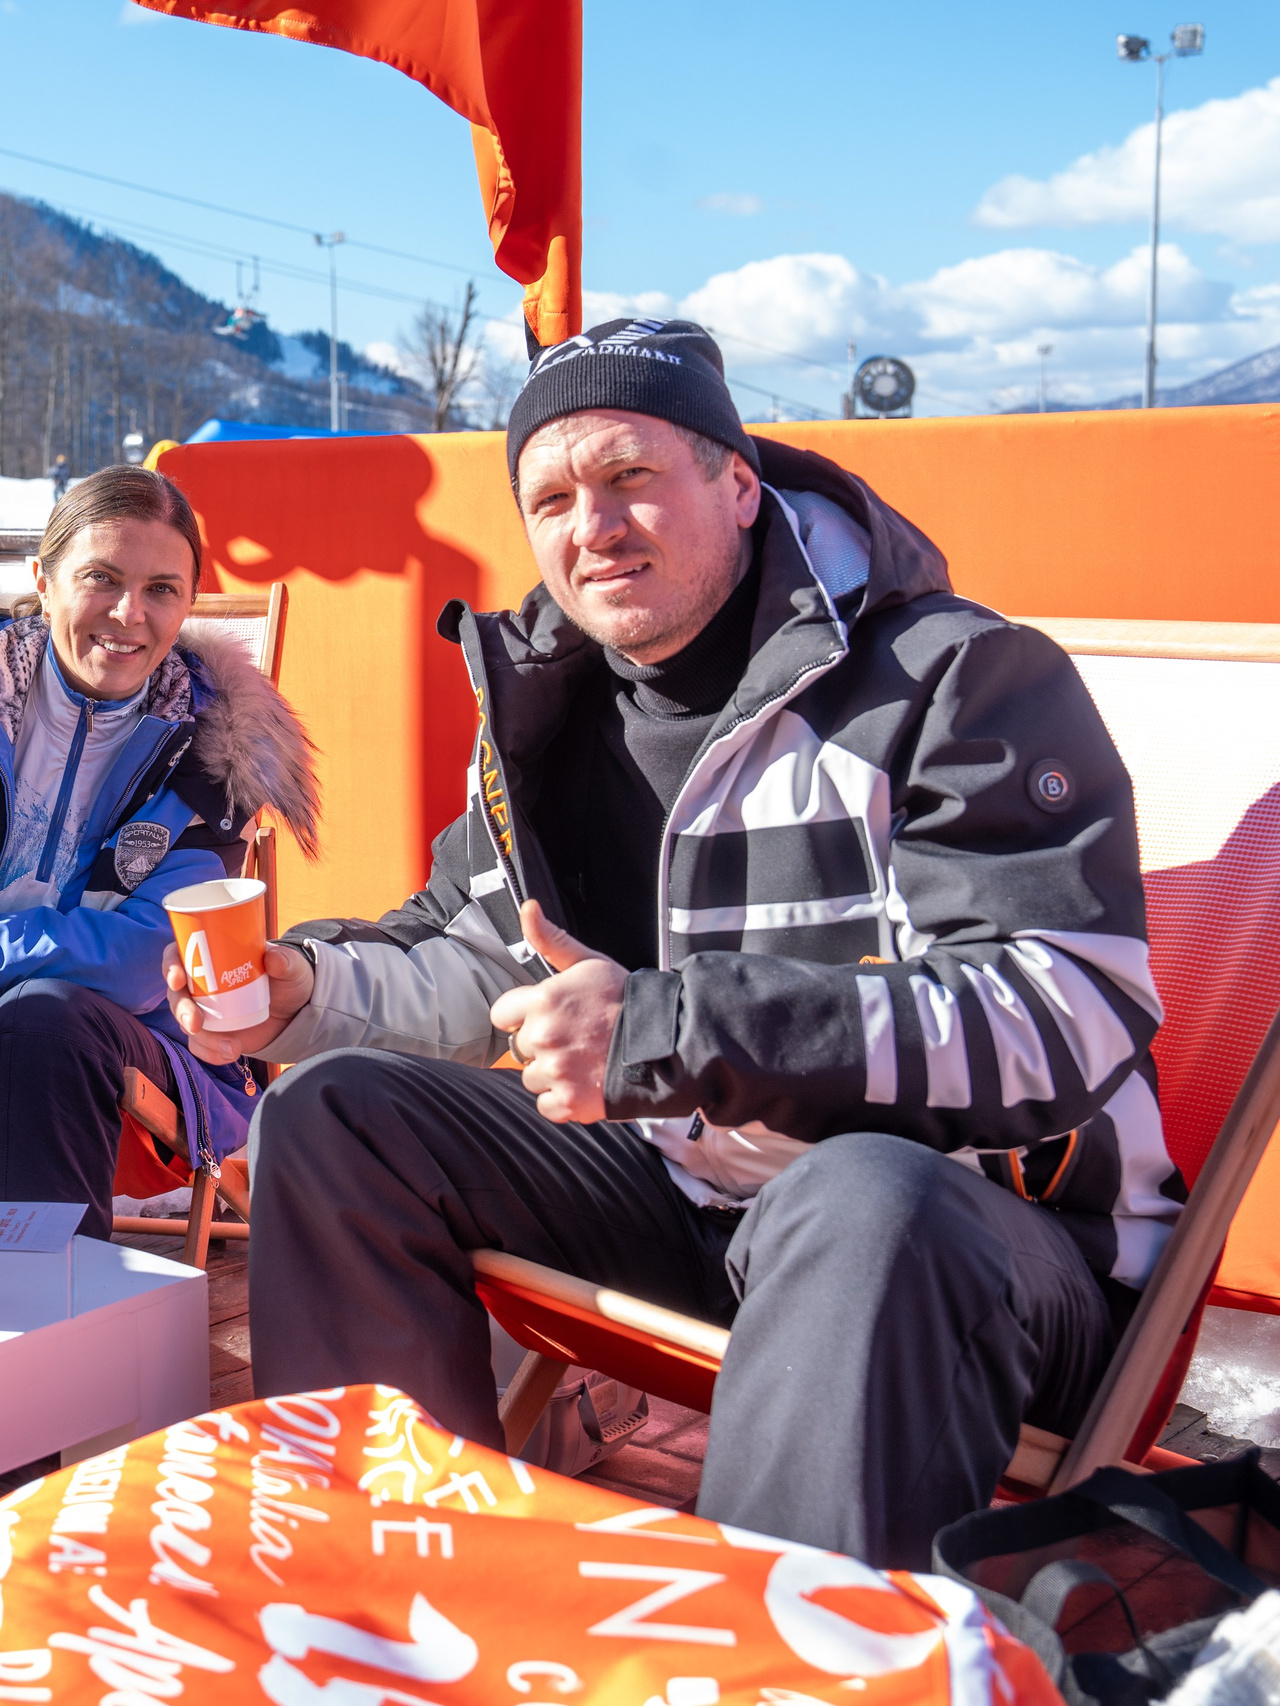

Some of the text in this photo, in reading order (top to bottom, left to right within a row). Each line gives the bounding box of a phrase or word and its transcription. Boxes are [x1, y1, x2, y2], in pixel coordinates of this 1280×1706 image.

[134, 840, 151, 849] 1953
[184, 929, 219, 994] A
[221, 960, 254, 984] APEROL
